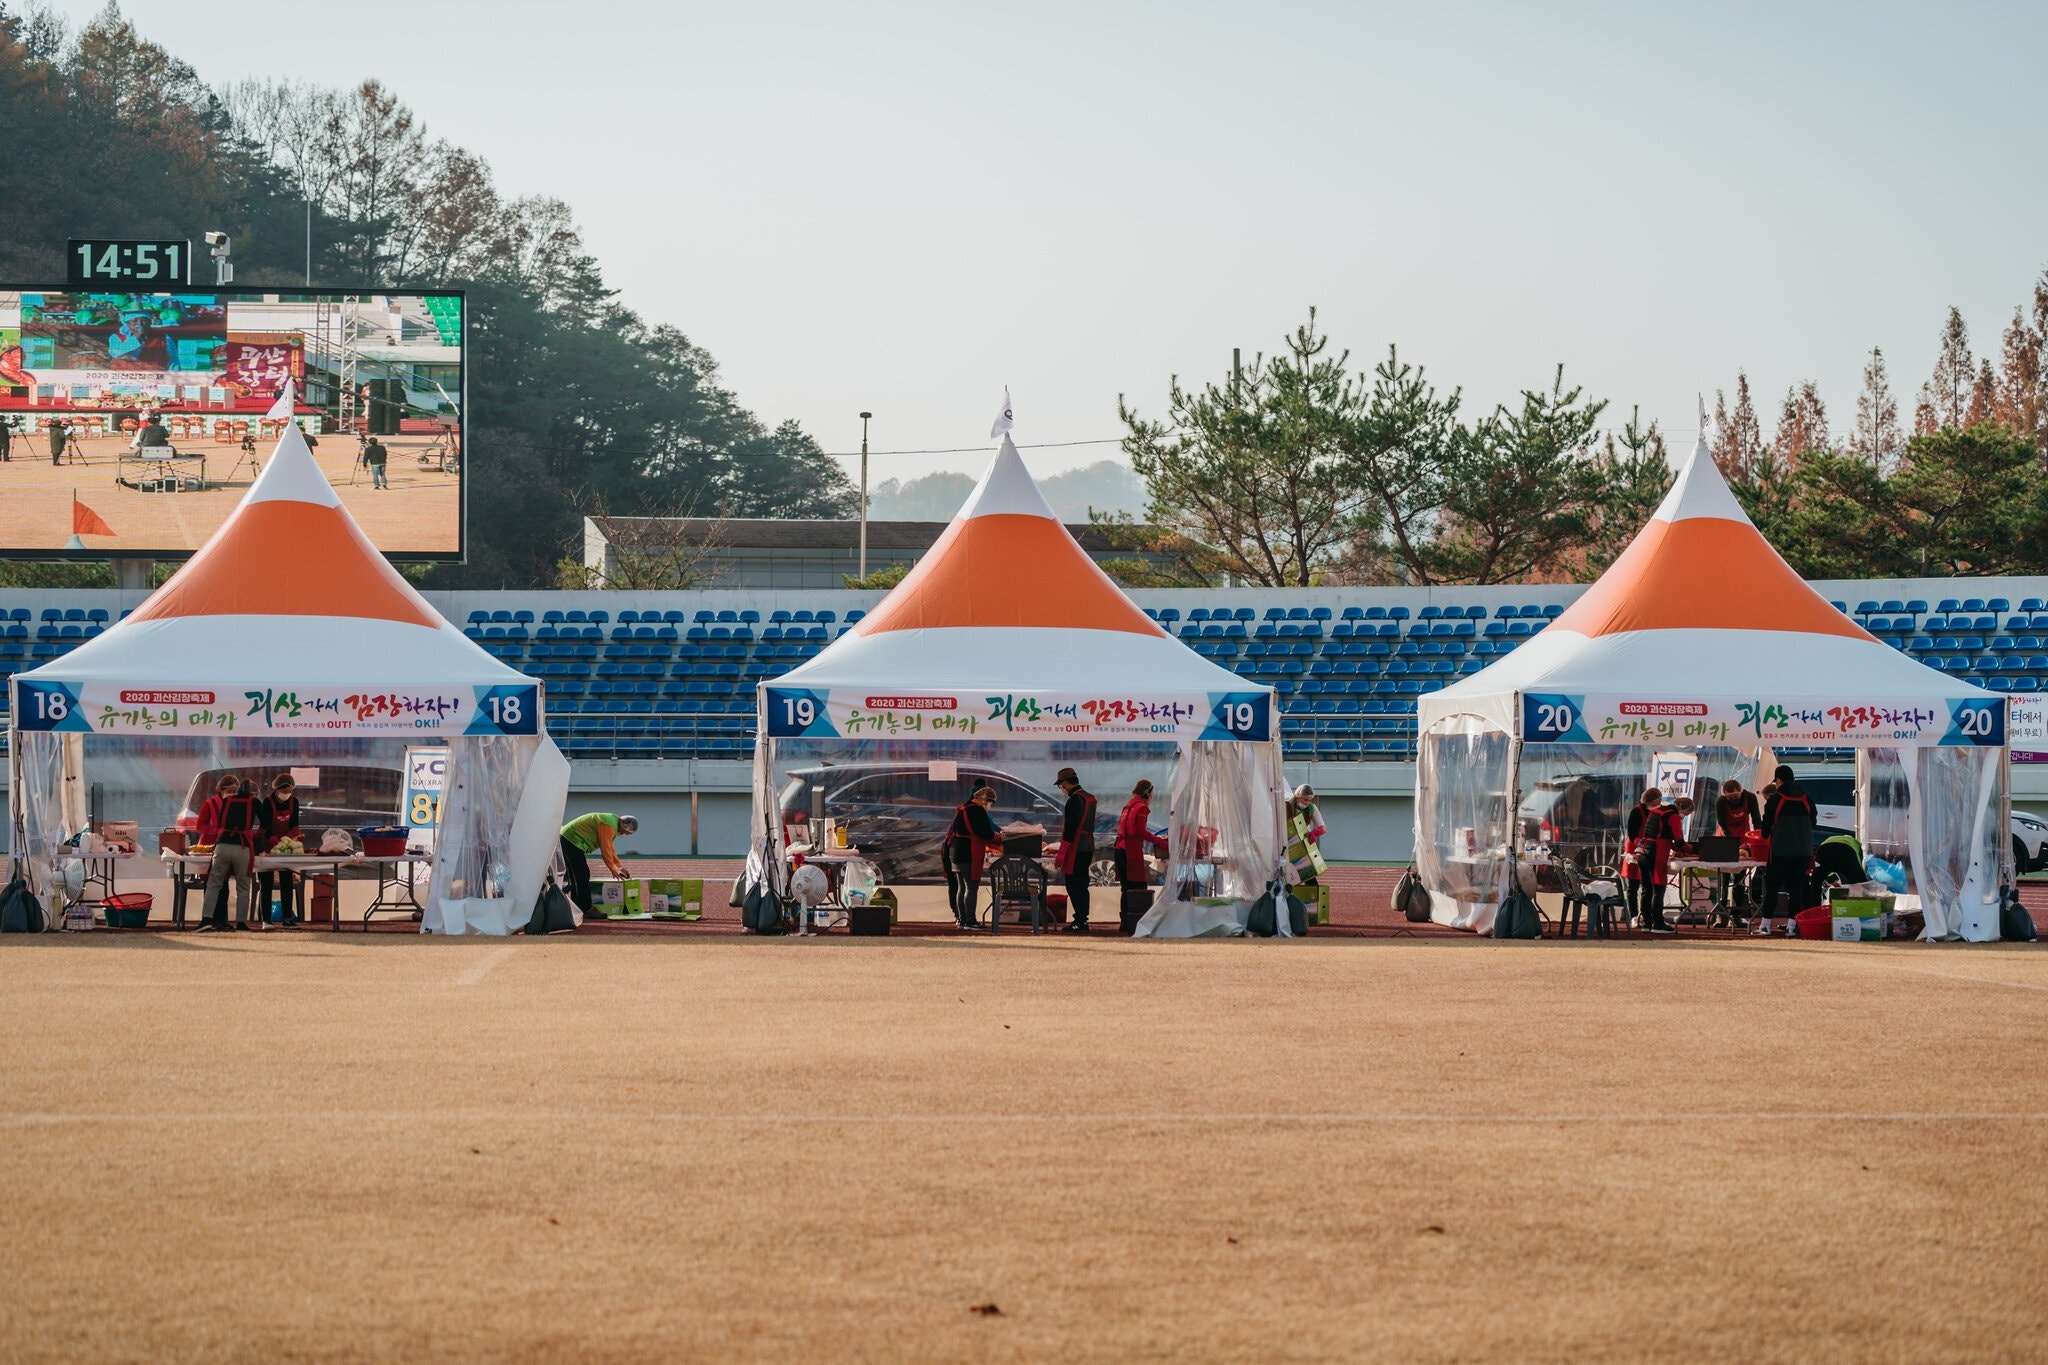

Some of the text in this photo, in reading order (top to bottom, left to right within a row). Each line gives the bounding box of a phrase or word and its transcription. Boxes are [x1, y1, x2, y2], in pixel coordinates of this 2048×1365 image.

[77, 244, 179, 280] 14:51
[237, 346, 287, 369] 괴산
[34, 692, 68, 720] 18
[125, 692, 210, 704] 2020 괴산김장축제
[344, 693, 459, 721] 김장하자!
[488, 696, 523, 725] 18
[871, 699, 952, 709] 2020 괴산김장축제
[1624, 704, 1703, 715] 2020 괴산김장축제
[98, 705, 238, 731] 유기농의 메카
[327, 720, 352, 729] OUT!
[415, 719, 440, 728] OK!!
[783, 698, 815, 726] 19
[844, 710, 980, 735] 유기농의 메카
[1081, 699, 1194, 726] 김장하자!
[1223, 703, 1254, 731] 19
[1537, 704, 1573, 733] 20
[1826, 704, 1934, 733] 김장하자!
[1960, 708, 1993, 736] 20
[1065, 724, 1090, 732] OUT!
[1151, 724, 1175, 733] OK!!
[1600, 716, 1730, 741] 유기농의 메카
[1812, 731, 1835, 739] OUT!
[1893, 730, 1917, 739] OK!!
[2024, 728, 2042, 738] 무료)
